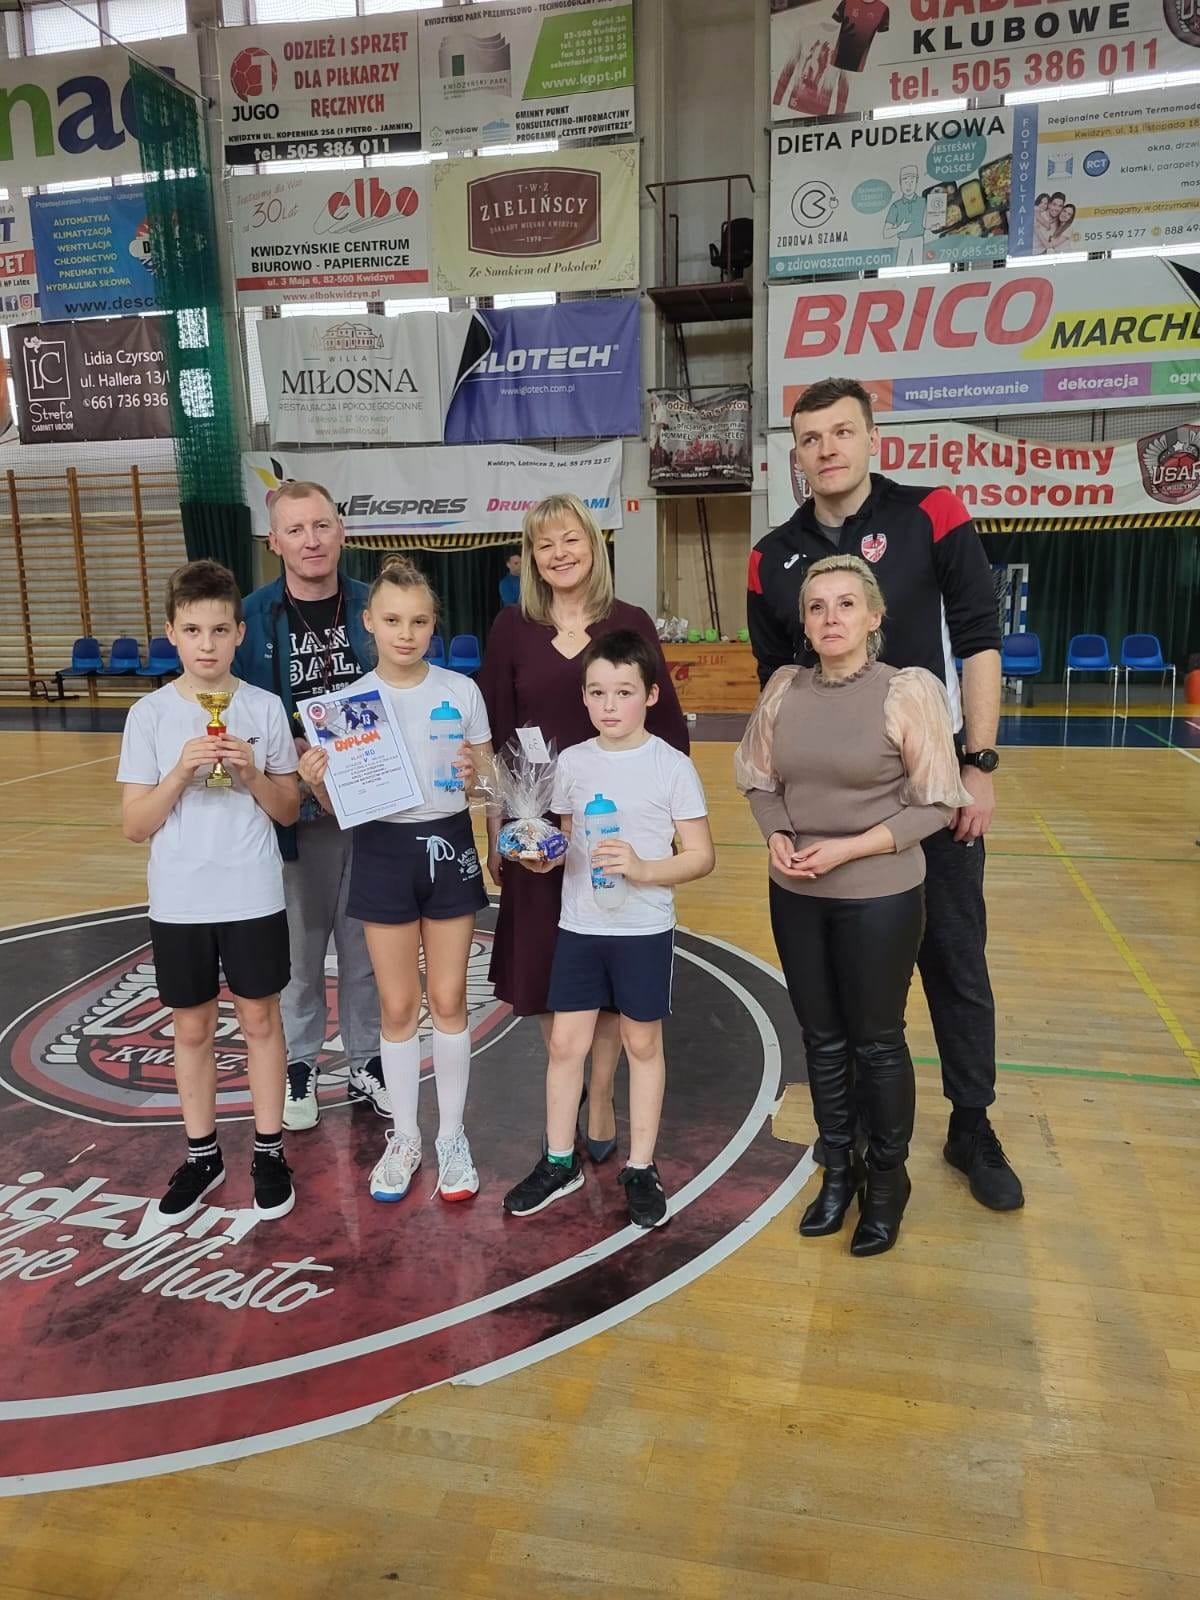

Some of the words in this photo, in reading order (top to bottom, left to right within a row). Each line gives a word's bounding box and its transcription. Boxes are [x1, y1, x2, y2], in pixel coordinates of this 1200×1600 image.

[465, 11, 482, 21] PARK
[913, 2, 1130, 55] KLUBOWE
[283, 34, 336, 61] ODZIEŻ
[341, 37, 345, 56] I
[351, 31, 409, 55] SPRZĘT
[294, 69, 322, 90] DLA
[327, 63, 400, 87] PIŁKARZY
[542, 66, 627, 89] www.kppt.pl
[890, 70, 939, 102] tel.
[952, 56, 1011, 94] 505
[1024, 48, 1085, 86] 386
[1098, 37, 1158, 76] 011
[231, 103, 280, 122] JUGO
[311, 93, 385, 119] RĘCZNYCH
[515, 108, 544, 119] GMINNY
[546, 105, 570, 117] PUNKT
[516, 109, 630, 131] KONSULTACYJNO-INFORMACYJNY
[1048, 112, 1100, 125] Regionalne
[1103, 109, 1143, 120] Centrum
[228, 134, 261, 143] KWIDZYN
[277, 129, 319, 139] KOPERNIKA
[346, 125, 373, 136] PIĘTRO
[380, 122, 414, 132] JAMNIK)
[516, 130, 556, 142] PROGRAMU
[777, 131, 842, 155] DIETA
[851, 115, 1005, 148] PUDEŁKOWA
[254, 145, 282, 161] tel.
[287, 143, 319, 159] 505
[323, 140, 355, 157] 386
[359, 137, 391, 155] 011
[932, 141, 978, 154] JESTEŚMY
[933, 155, 943, 164] W
[945, 153, 976, 163] CAŁEJ
[1086, 158, 1108, 170] RCT
[935, 163, 973, 175] POLSCE
[1017, 118, 1030, 247] FOTOWOLTAIKA
[328, 177, 419, 221] elbo
[252, 199, 282, 229] 30
[480, 195, 589, 222] ZIELIŃSCY
[54, 213, 110, 226] AUTOMATYKA
[53, 226, 113, 239] KLIMATYZACJA
[777, 234, 814, 248] ZDROWA
[817, 231, 849, 244] SZAMA
[1084, 231, 1103, 241] 505
[1106, 230, 1124, 240] 549
[1127, 228, 1146, 238] 177
[1164, 225, 1184, 236] 888
[58, 240, 112, 253] WENTYLACJA
[251, 241, 340, 257] KWIDZYŃSKIE
[344, 239, 410, 252] CENTRUM
[54, 253, 118, 266] CHŁODNICTWO
[252, 260, 312, 273] BIUROWO
[324, 255, 410, 270] PAPIERNICZE
[468, 266, 482, 278] Ze
[486, 264, 534, 277] Smakiem
[536, 262, 551, 275] od
[553, 259, 602, 274] Pokoleń!
[59, 266, 115, 279] PNEUMATYKA
[288, 276, 311, 288] Maja
[323, 275, 354, 285] 82-500
[356, 273, 395, 284] Kwidzyn
[46, 280, 97, 292] HYDRAULIKA
[99, 276, 132, 288] SIŁOWA
[282, 289, 381, 302] www.elbokwidzyn.pl
[783, 276, 1054, 360] BRICO
[84, 351, 113, 366] Lidia
[116, 349, 165, 366] Czyrson
[329, 355, 368, 363] WILLA
[80, 374, 95, 388] ul.
[99, 373, 141, 387] Hallera
[281, 368, 418, 395] MIŁOSNA
[905, 381, 1029, 402] majsterkowanie
[1057, 373, 1140, 391] dekoracja
[91, 396, 113, 409] 661
[119, 394, 140, 408] 736
[144, 392, 169, 406] 936
[29, 402, 73, 423] Strefa
[32, 423, 54, 432] GABINET
[880, 433, 1114, 476] Dziękujemy
[935, 484, 1114, 507] nsorom
[361, 714, 372, 724] 13
[0, 1171, 262, 1249] idzyn
[75, 1232, 334, 1313] Miasto
